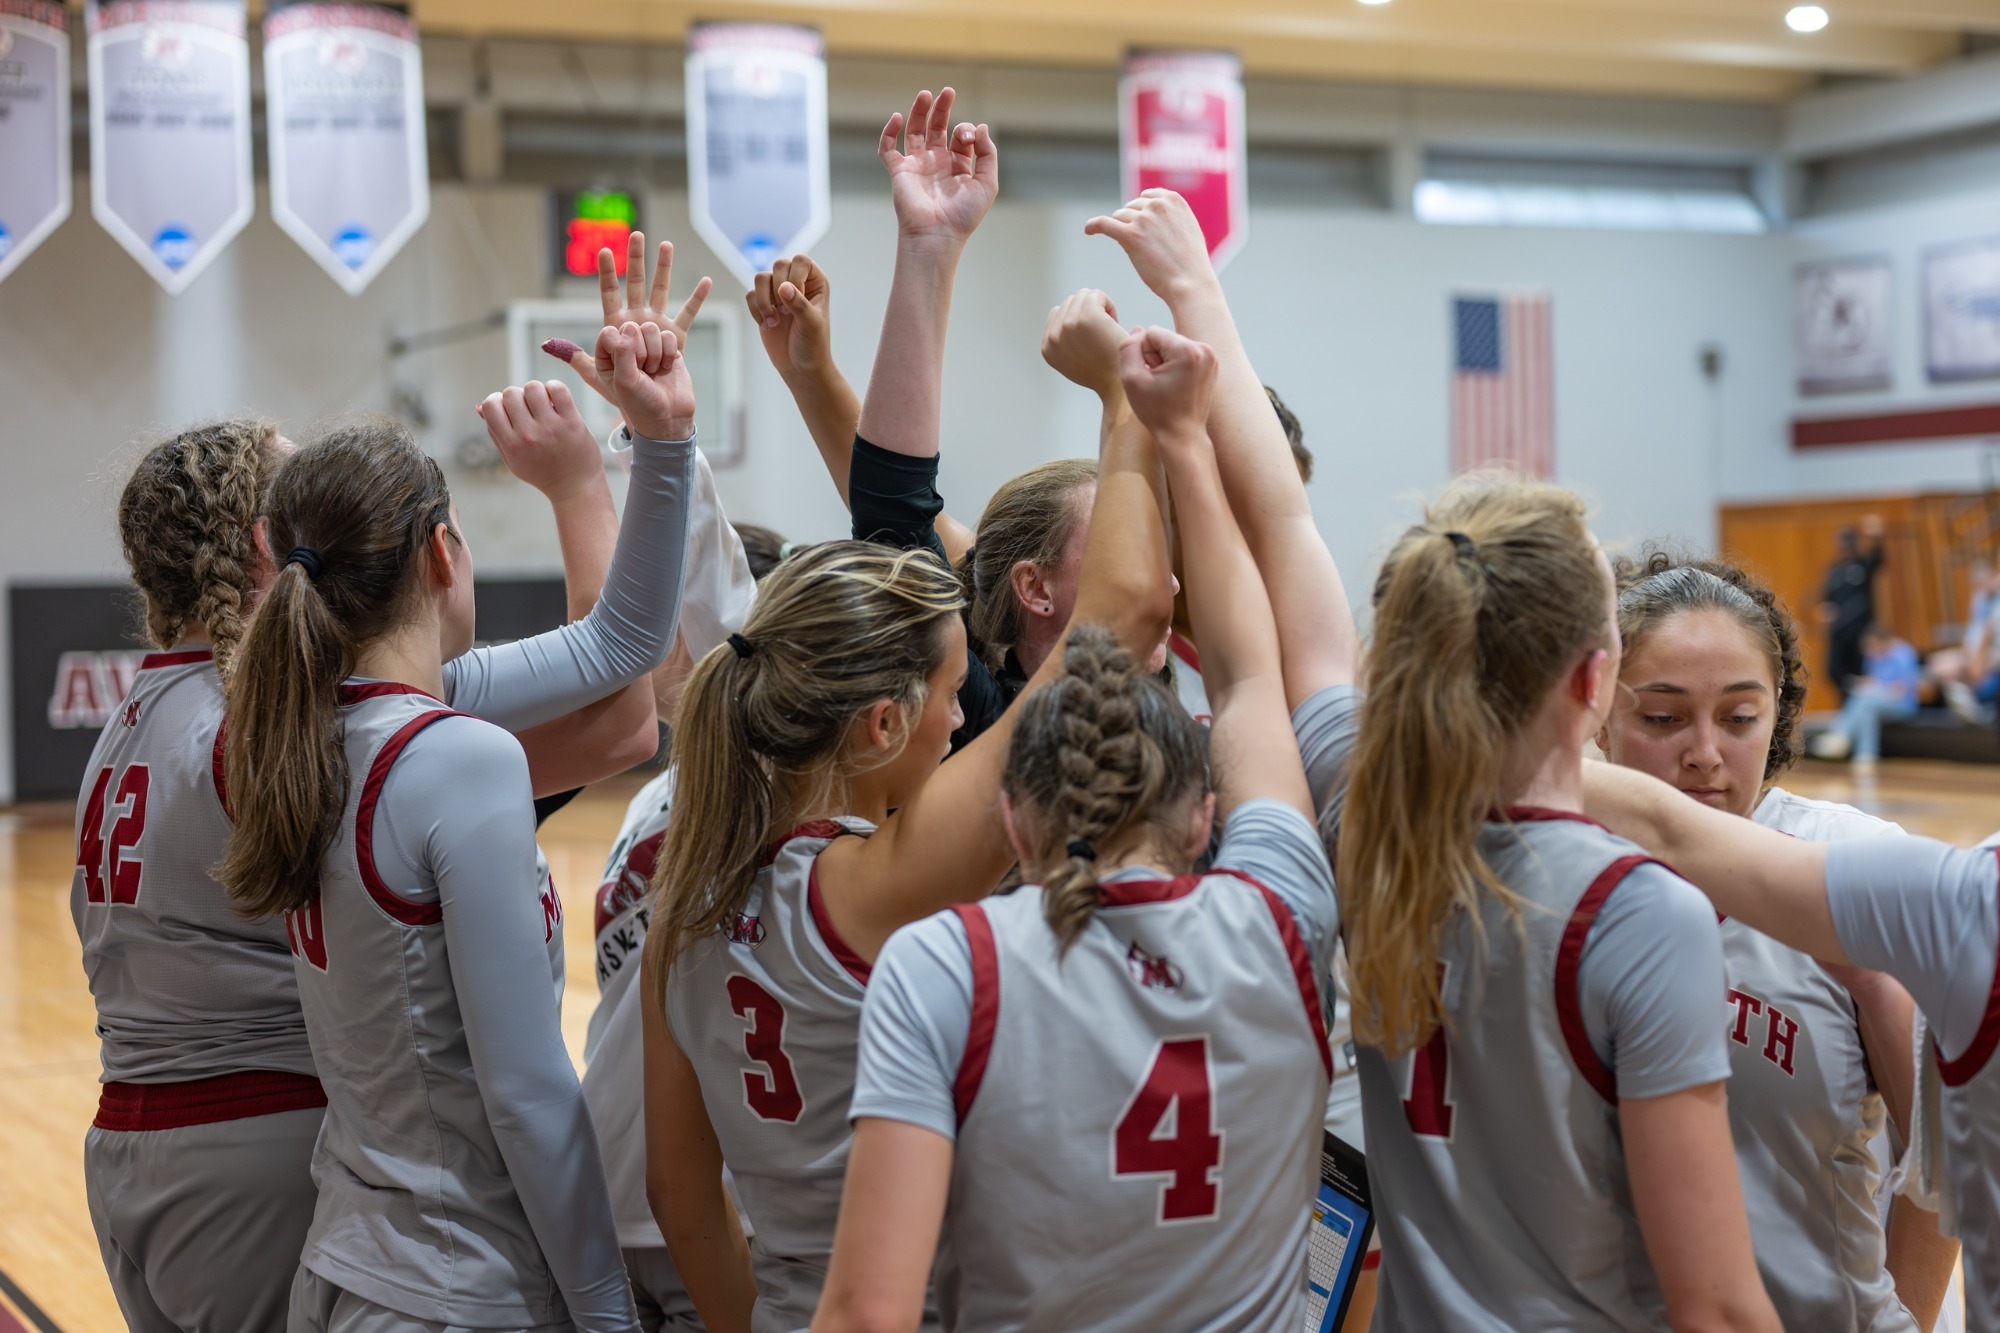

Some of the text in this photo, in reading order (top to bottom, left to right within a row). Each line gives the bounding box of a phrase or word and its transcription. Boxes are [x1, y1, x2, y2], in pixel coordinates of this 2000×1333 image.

[76, 761, 151, 908] 42
[725, 971, 805, 1124] 3
[1726, 987, 1800, 1079] TH
[1110, 1034, 1226, 1226] 4
